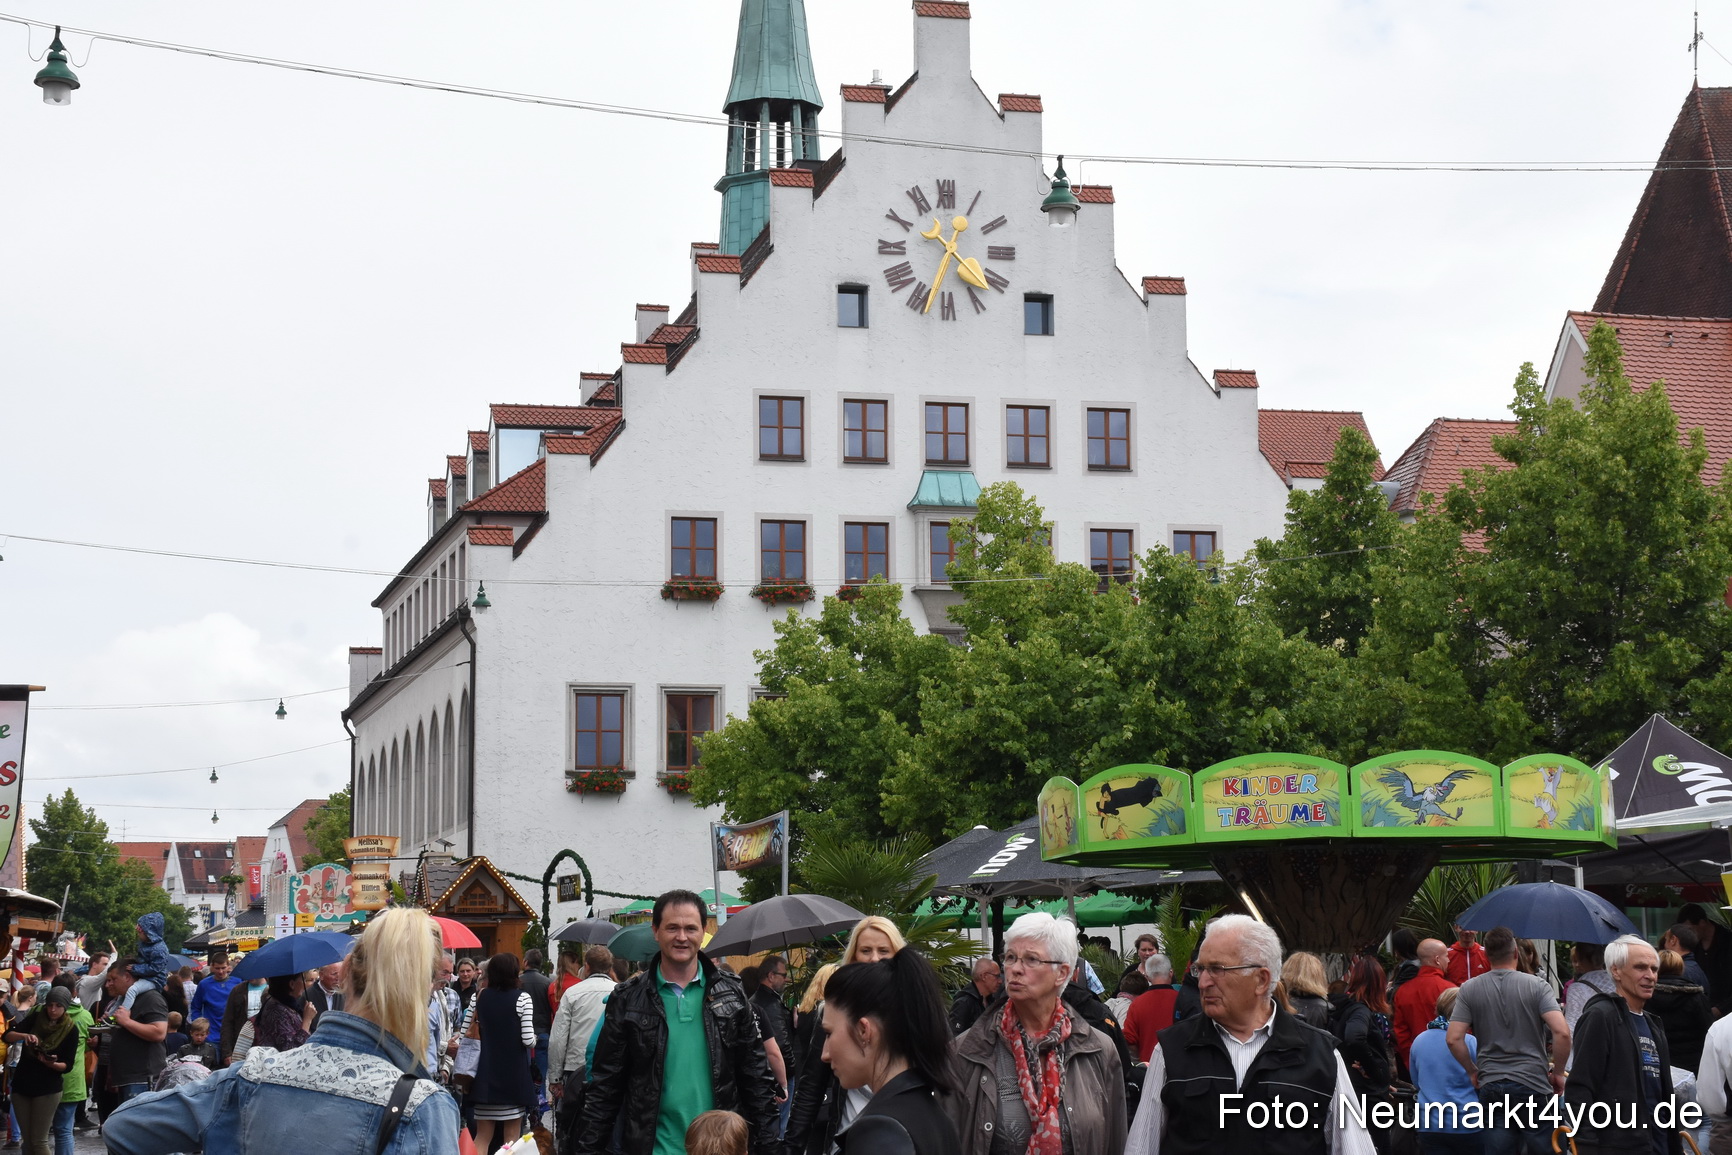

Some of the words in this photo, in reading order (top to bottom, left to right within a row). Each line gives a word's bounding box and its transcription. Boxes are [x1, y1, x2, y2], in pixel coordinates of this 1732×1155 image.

[1222, 774, 1319, 798] KINDER
[1217, 800, 1327, 828] TRÄUME
[358, 838, 384, 847] Melissa's
[353, 872, 387, 881] Schmankerl
[230, 929, 264, 937] POPCORN
